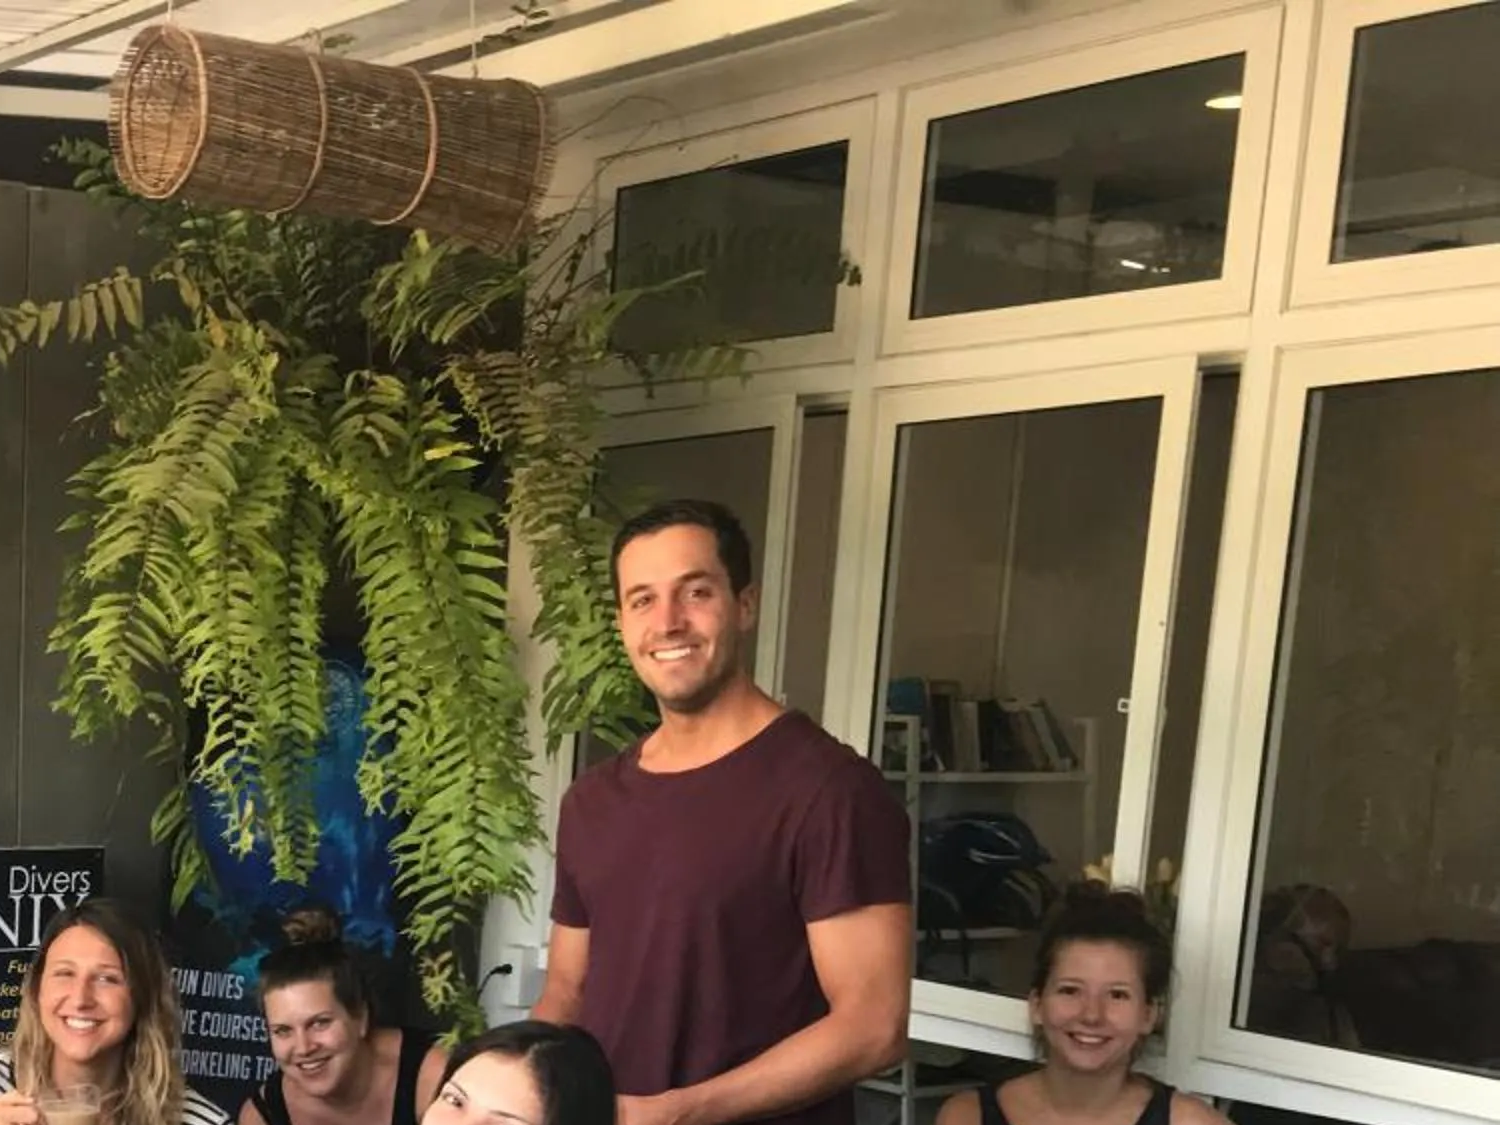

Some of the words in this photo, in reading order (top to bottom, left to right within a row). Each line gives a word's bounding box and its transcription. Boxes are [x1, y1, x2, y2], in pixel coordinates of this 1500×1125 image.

[9, 865, 92, 894] Divers
[201, 971, 245, 1000] DIVES
[181, 1049, 252, 1079] ORKELING
